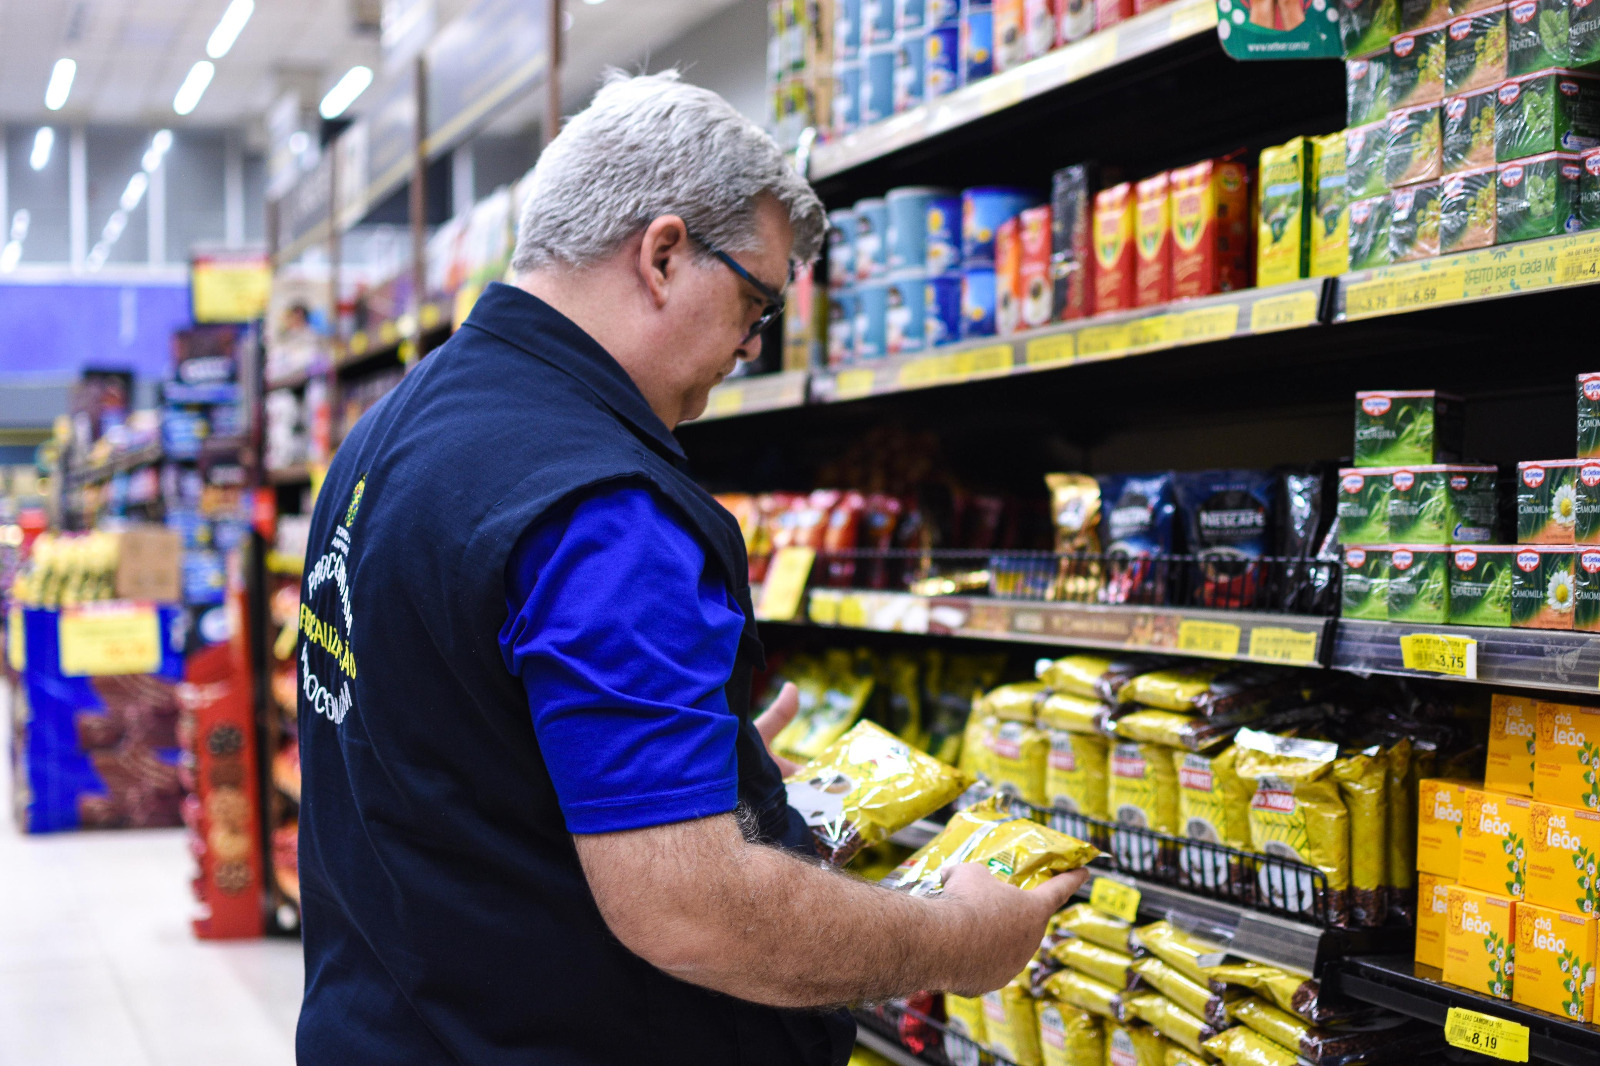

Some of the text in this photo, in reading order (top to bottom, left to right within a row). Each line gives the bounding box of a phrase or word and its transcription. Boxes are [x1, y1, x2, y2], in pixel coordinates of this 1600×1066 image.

[1495, 264, 1516, 281] para
[1519, 258, 1541, 276] cada
[1512, 588, 1543, 599] CAMOMILA
[1440, 654, 1464, 670] 3,75
[1507, 704, 1522, 717] chá
[1555, 713, 1572, 726] chá
[1435, 790, 1451, 803] chá
[1482, 802, 1498, 815] chá
[1548, 815, 1566, 829] chá
[1547, 827, 1580, 851] leão
[1463, 900, 1478, 914] chá
[1534, 917, 1552, 931] chá
[1534, 929, 1565, 954] leão
[1472, 1032, 1497, 1050] 8,19
